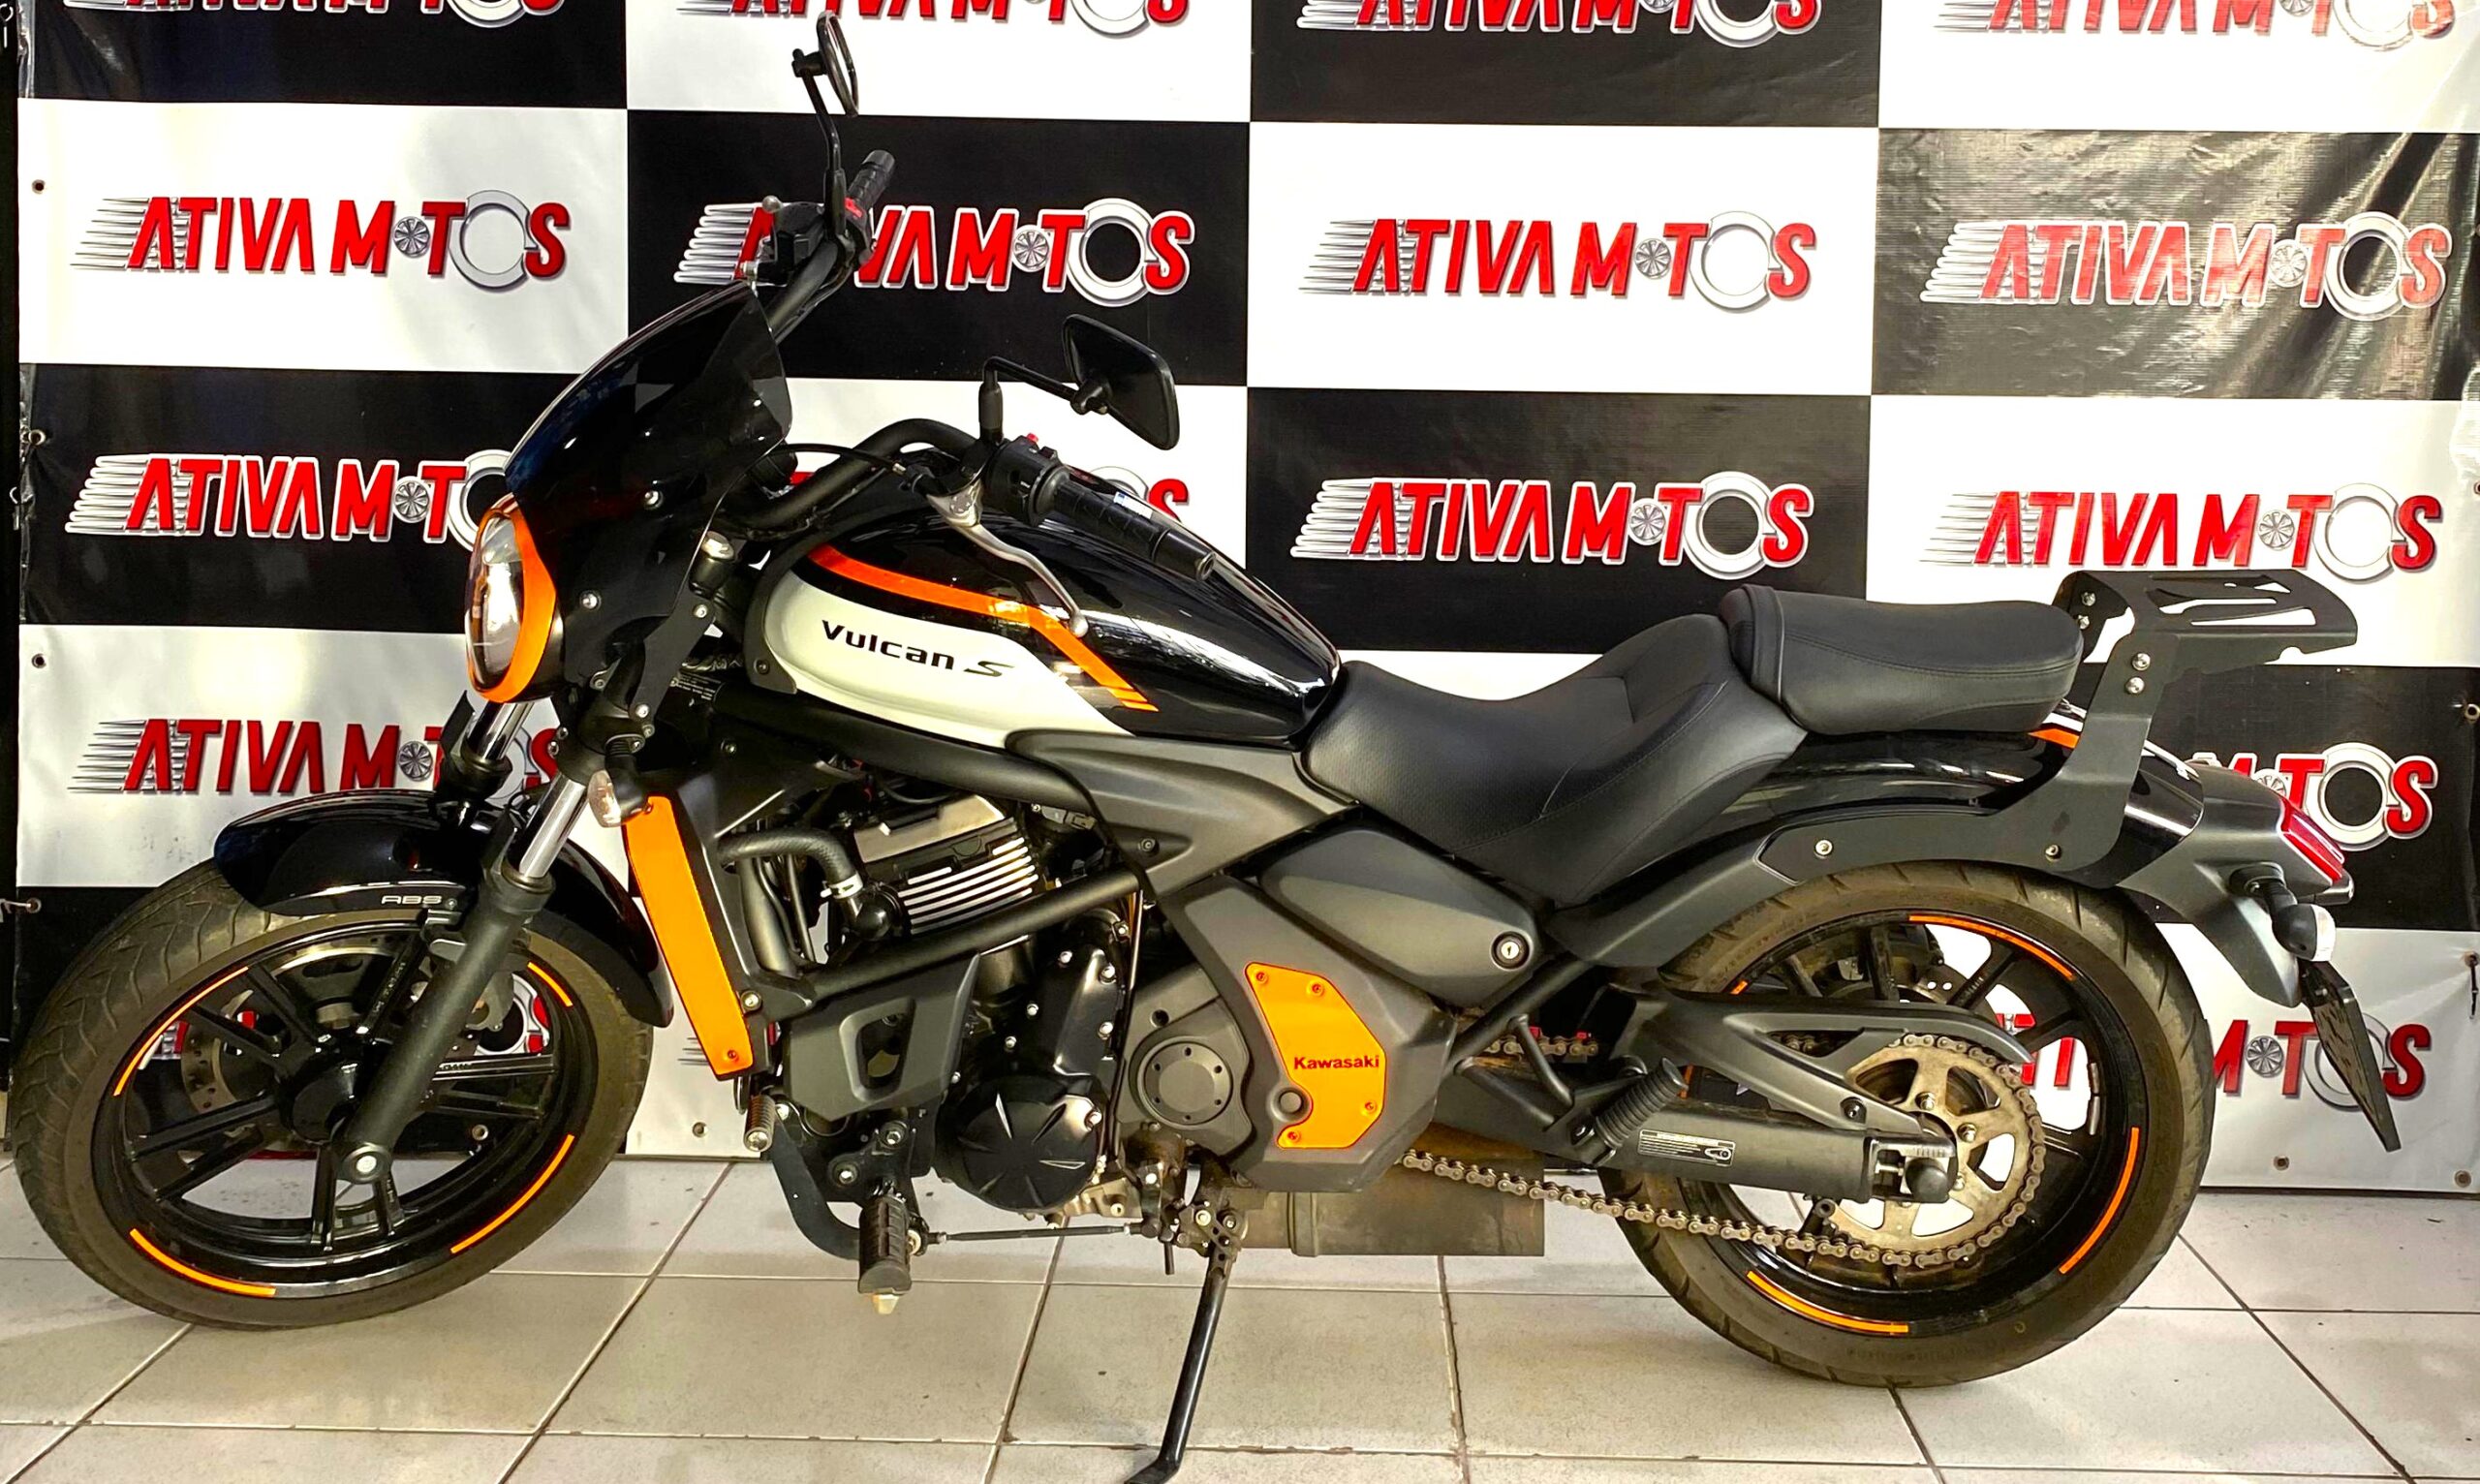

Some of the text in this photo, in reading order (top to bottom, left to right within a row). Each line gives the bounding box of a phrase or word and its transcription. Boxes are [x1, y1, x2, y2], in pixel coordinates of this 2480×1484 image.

[822, 619, 1015, 678] Vulcan S
[381, 895, 443, 906] ABS
[1293, 1055, 1380, 1070] Kawasaki
